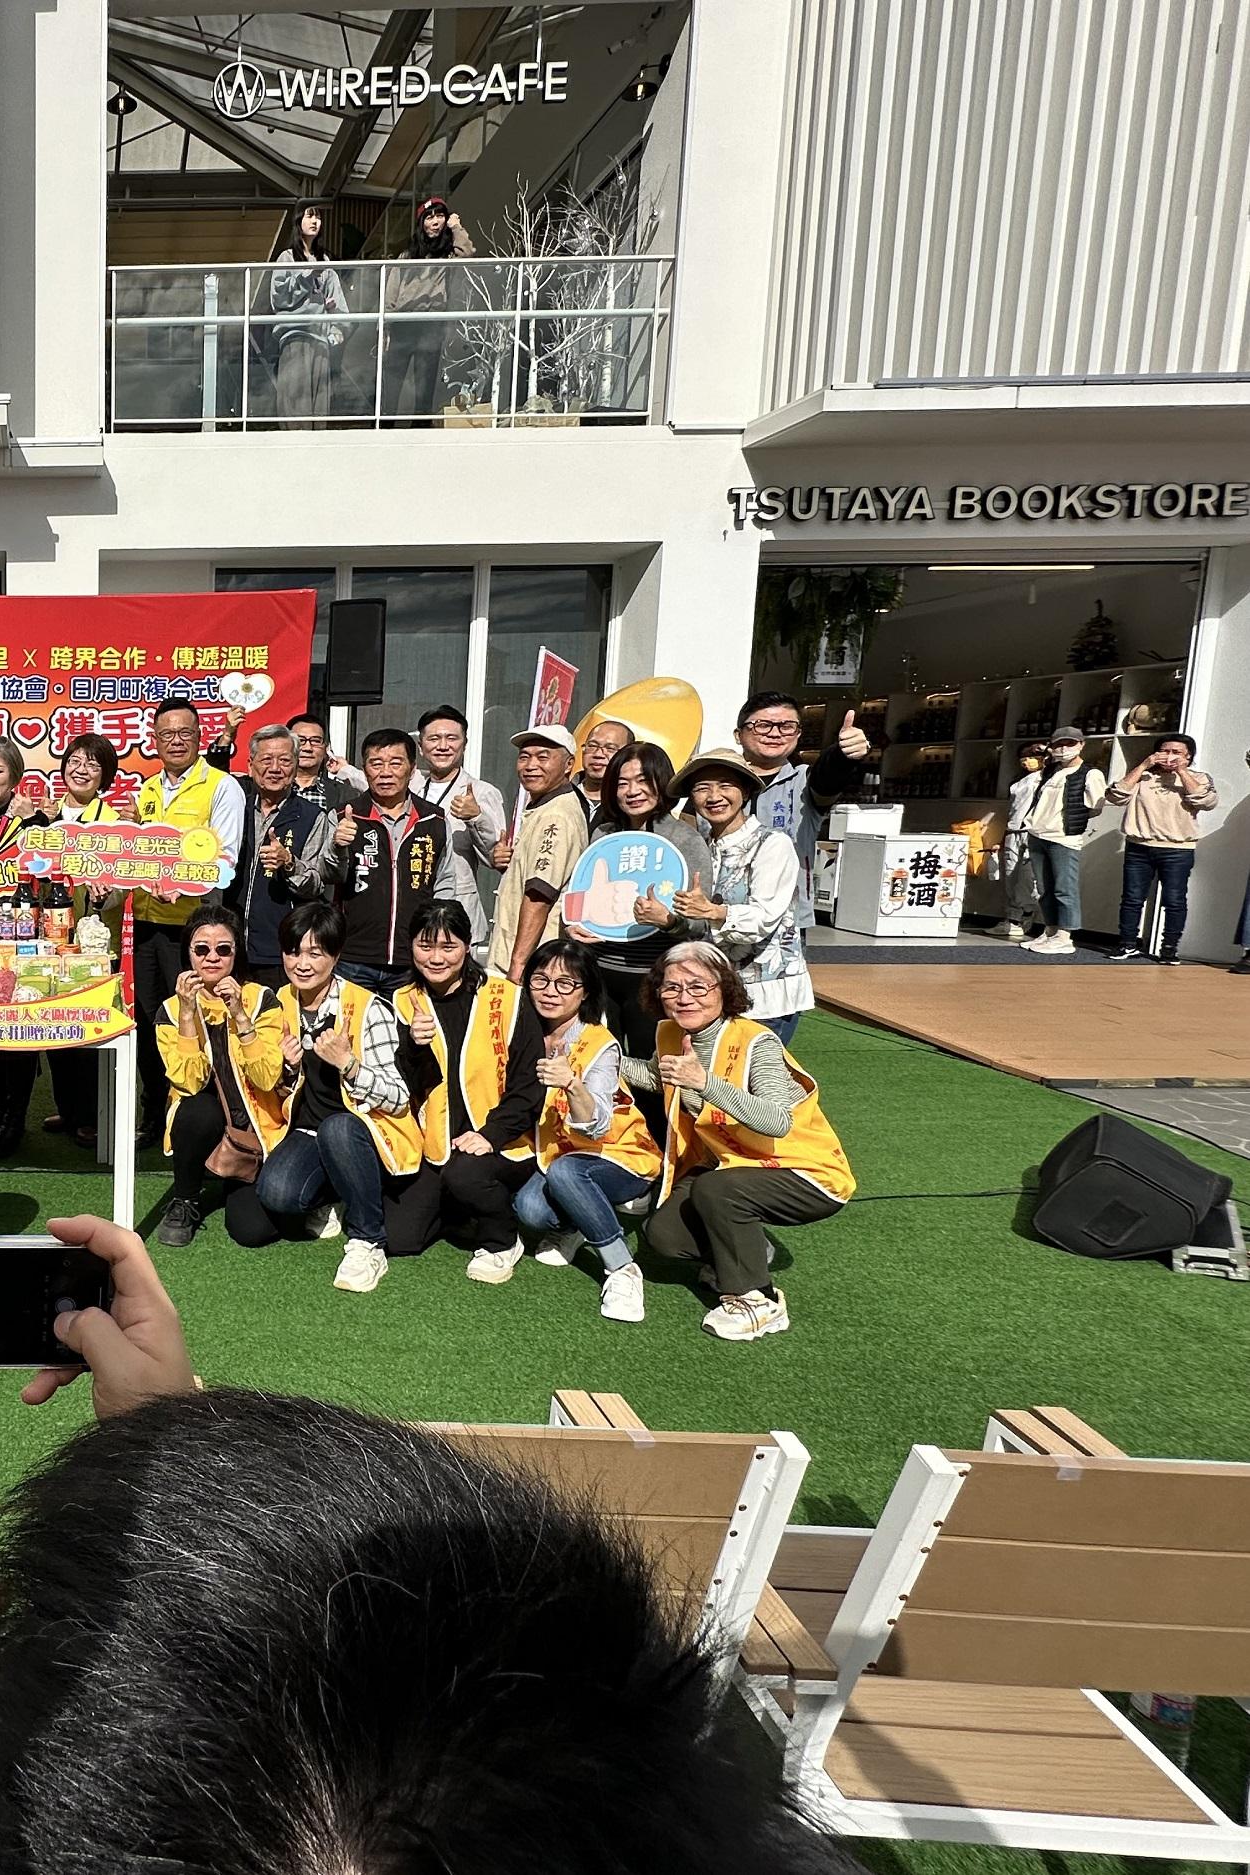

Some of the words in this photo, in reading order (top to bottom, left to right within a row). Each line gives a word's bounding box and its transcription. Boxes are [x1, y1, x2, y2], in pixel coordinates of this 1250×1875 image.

[280, 66, 431, 108] WIRED
[443, 61, 569, 105] CAFE
[731, 486, 934, 522] TSUTAYA
[952, 482, 1250, 521] BOOKSTORE
[53, 707, 230, 756] 攜手愛
[363, 829, 379, 868] FILA
[908, 850, 943, 908] 梅酒
